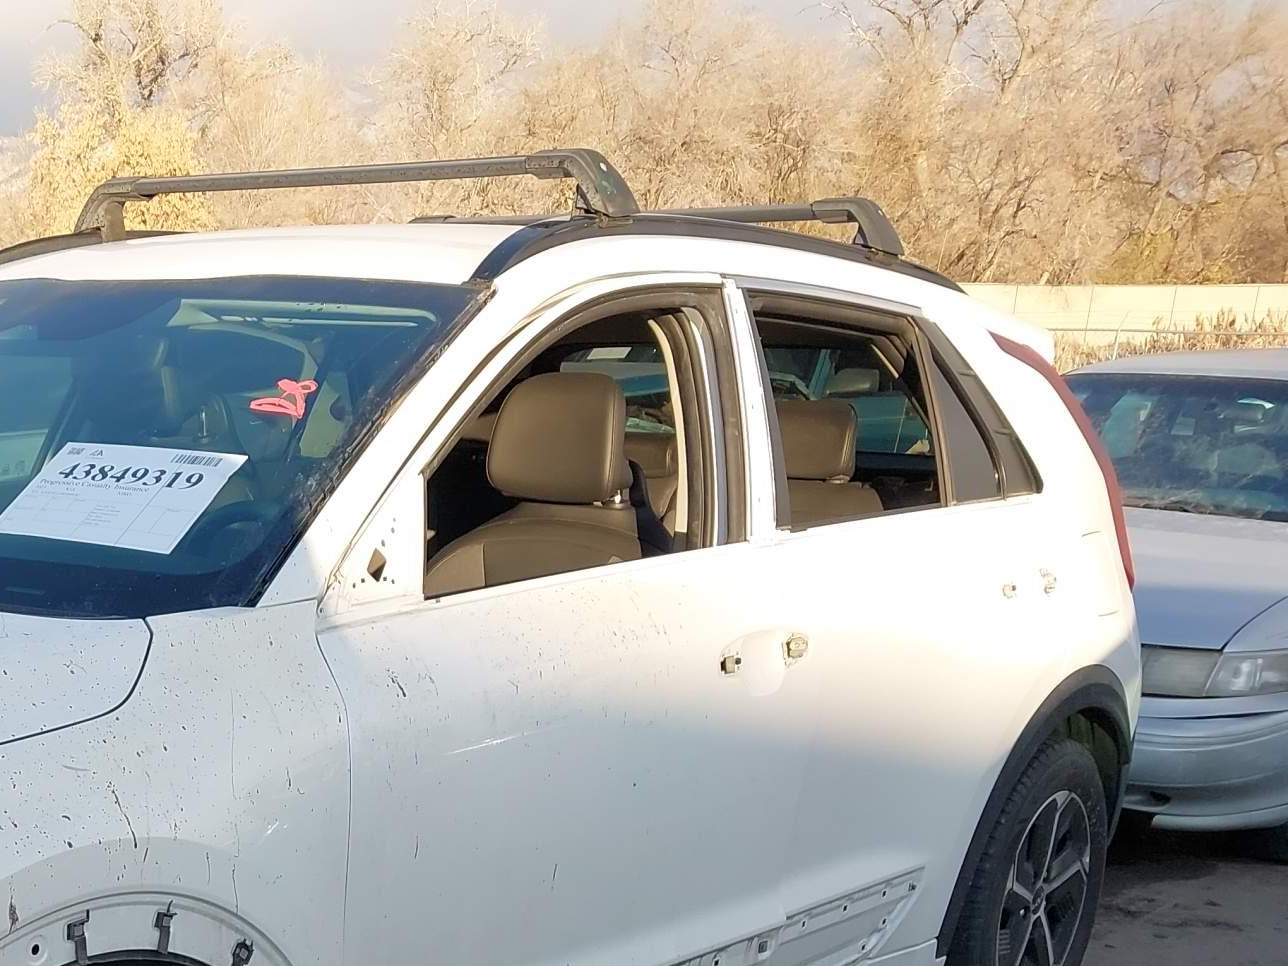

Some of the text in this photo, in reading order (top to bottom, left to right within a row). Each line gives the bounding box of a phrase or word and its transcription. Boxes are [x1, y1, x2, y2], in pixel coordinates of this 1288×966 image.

[40, 478, 81, 487] Progressive
[113, 484, 150, 492] Insurance
[58, 462, 204, 490] 43849319
